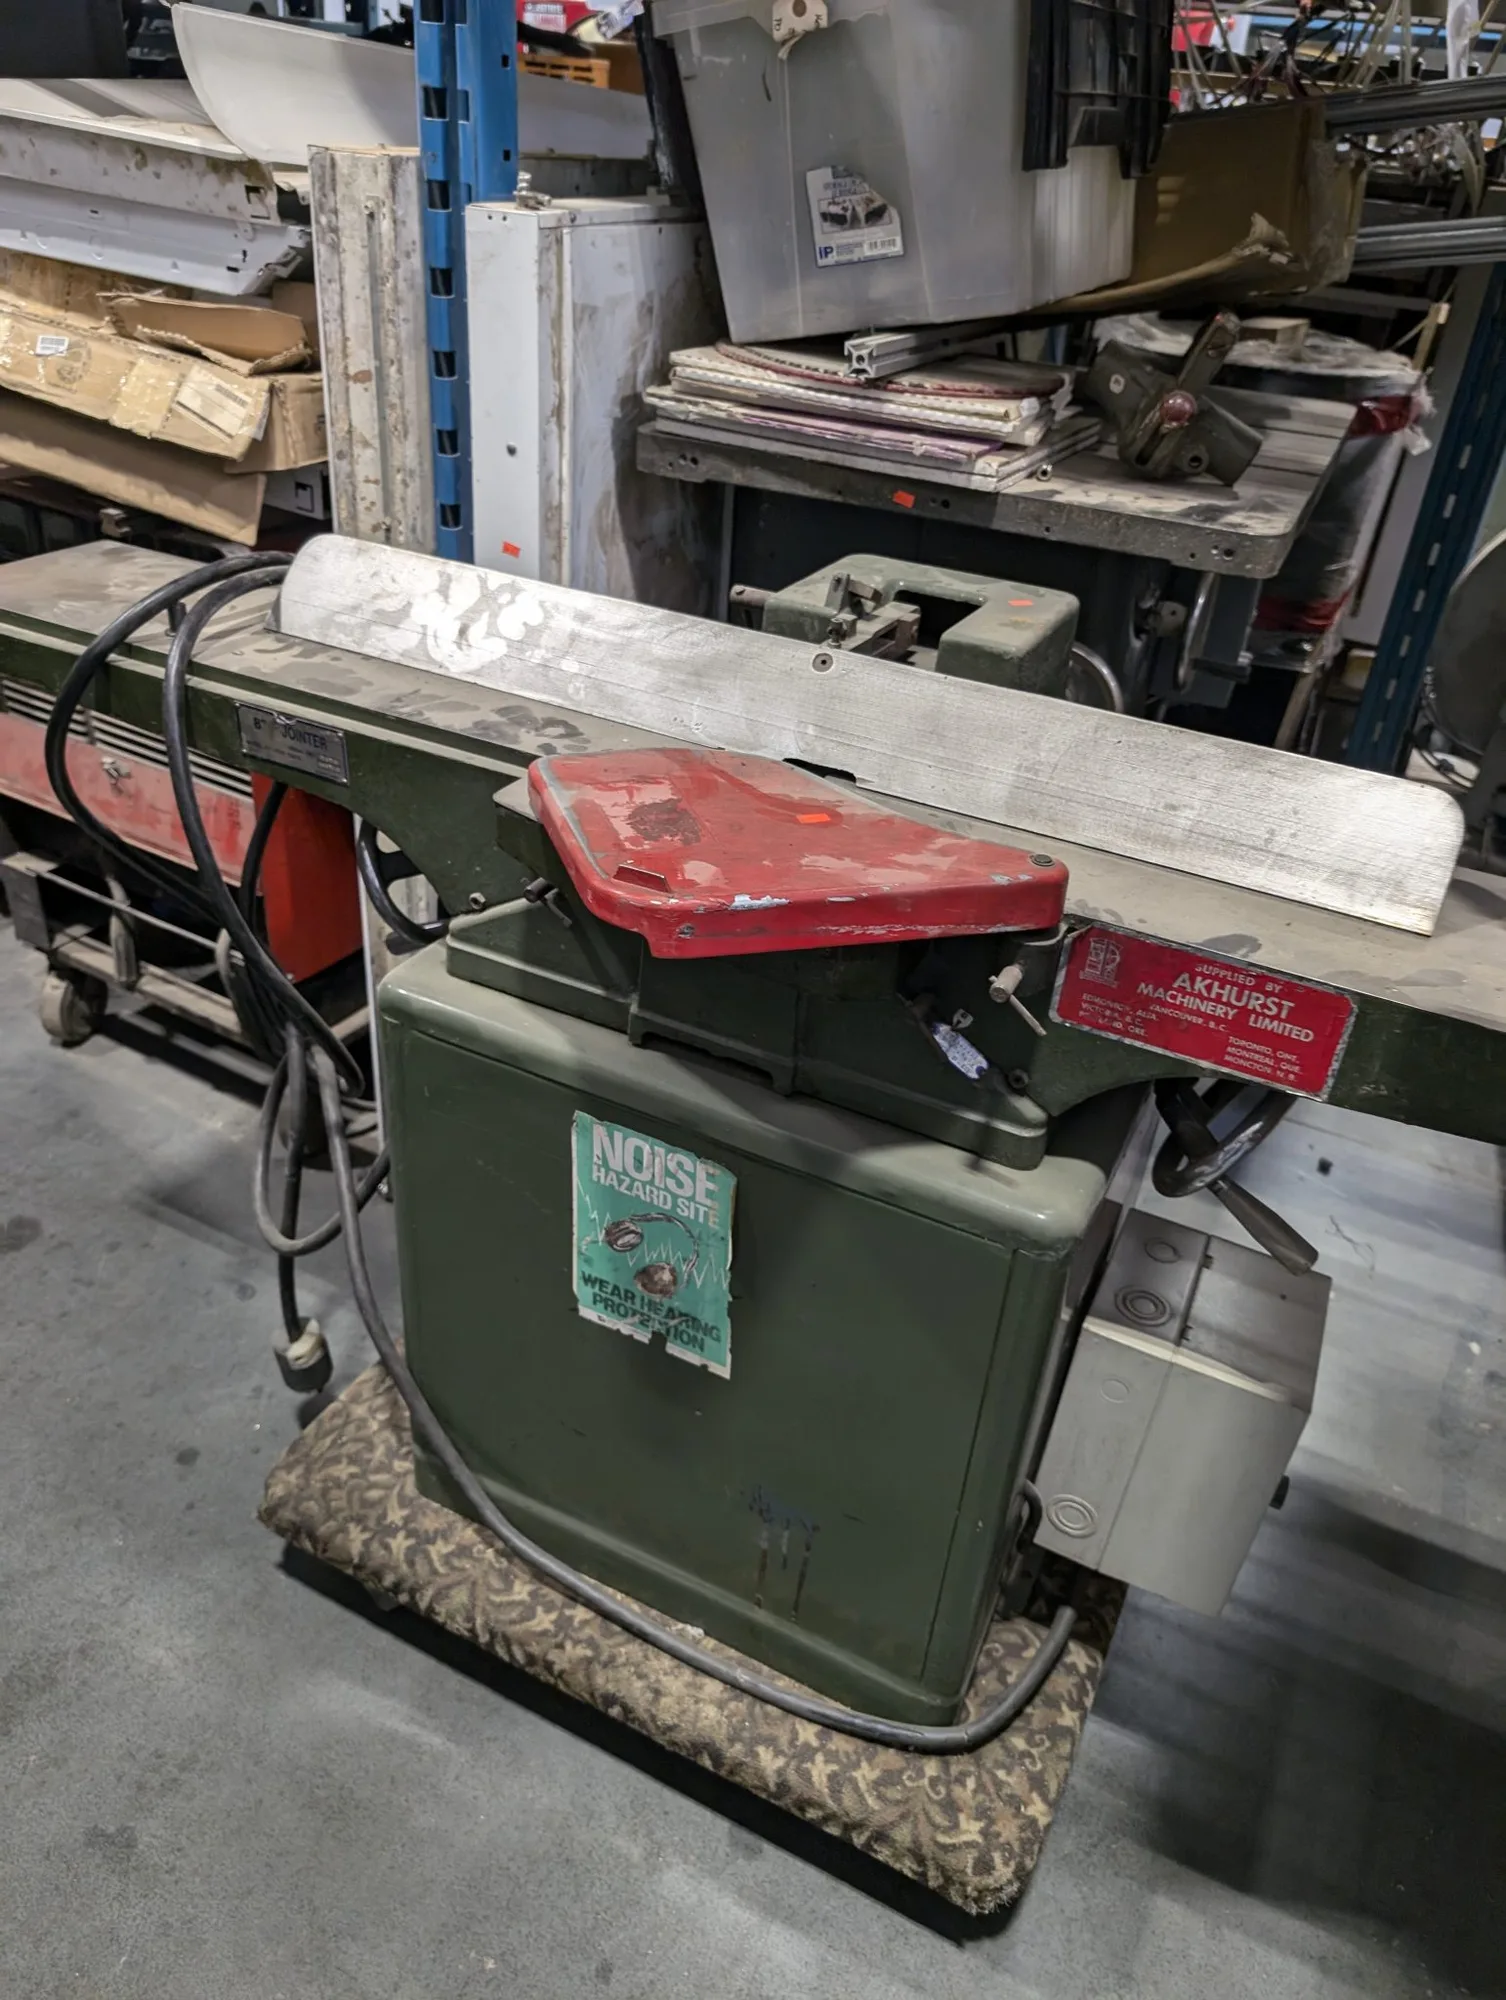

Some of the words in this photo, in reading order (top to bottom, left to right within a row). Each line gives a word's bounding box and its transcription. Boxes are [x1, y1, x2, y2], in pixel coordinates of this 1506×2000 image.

[282, 723, 328, 751] JOINTER
[1172, 971, 1295, 1020] AKHURST
[1195, 963, 1256, 986] SUPPLIED
[1265, 981, 1283, 994] BY
[1137, 982, 1238, 1020] MACHINERY
[1249, 1013, 1315, 1043] LIMITED
[593, 1123, 721, 1208] NOISE
[592, 1163, 672, 1211] HAZARD
[676, 1198, 720, 1230] SITE
[581, 1271, 637, 1306] WEAR
[592, 1291, 705, 1353] PROTETION
